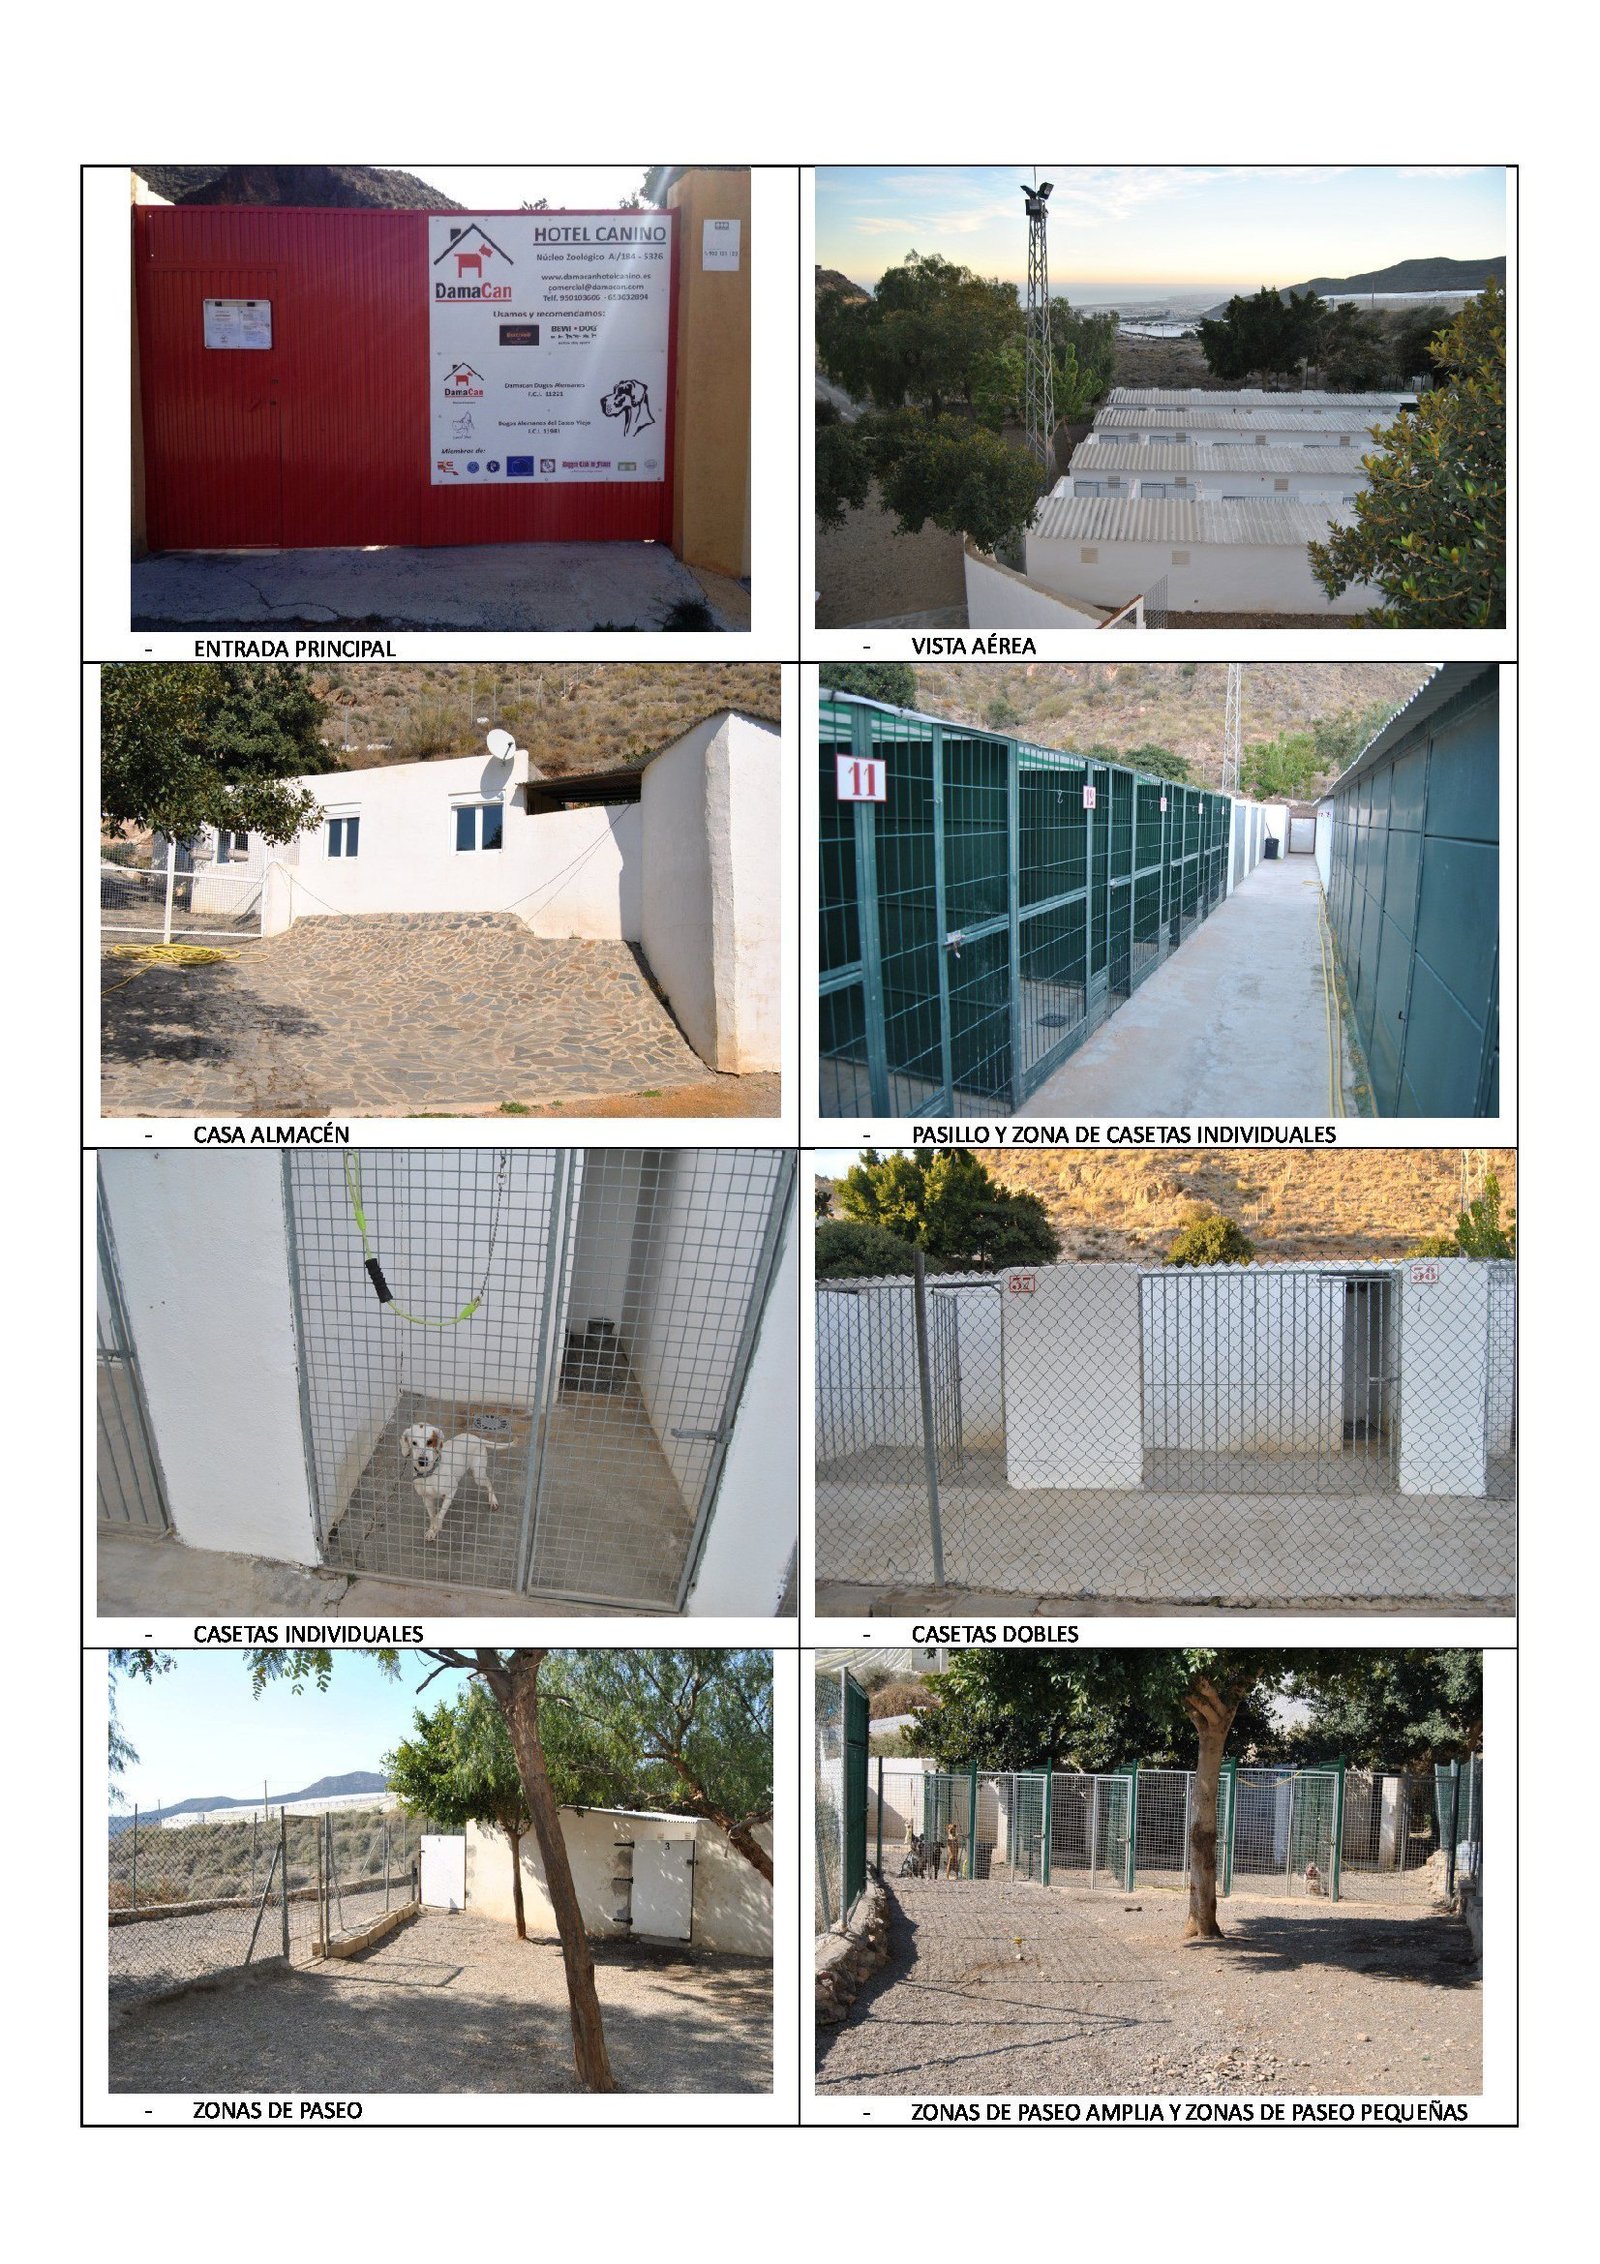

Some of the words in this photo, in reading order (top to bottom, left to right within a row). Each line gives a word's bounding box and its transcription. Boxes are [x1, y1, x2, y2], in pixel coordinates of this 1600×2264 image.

[534, 227, 591, 242] HOTEL
[596, 226, 666, 241] CANINO
[536, 253, 564, 261] Núcleo
[566, 252, 605, 262] Zoológico
[435, 282, 512, 299] DamaCan
[493, 310, 528, 318] Usamos
[536, 309, 606, 318] recomendamos:
[444, 388, 484, 396] DamaCan
[848, 761, 876, 797] 11
[664, 1842, 671, 1851] 3
